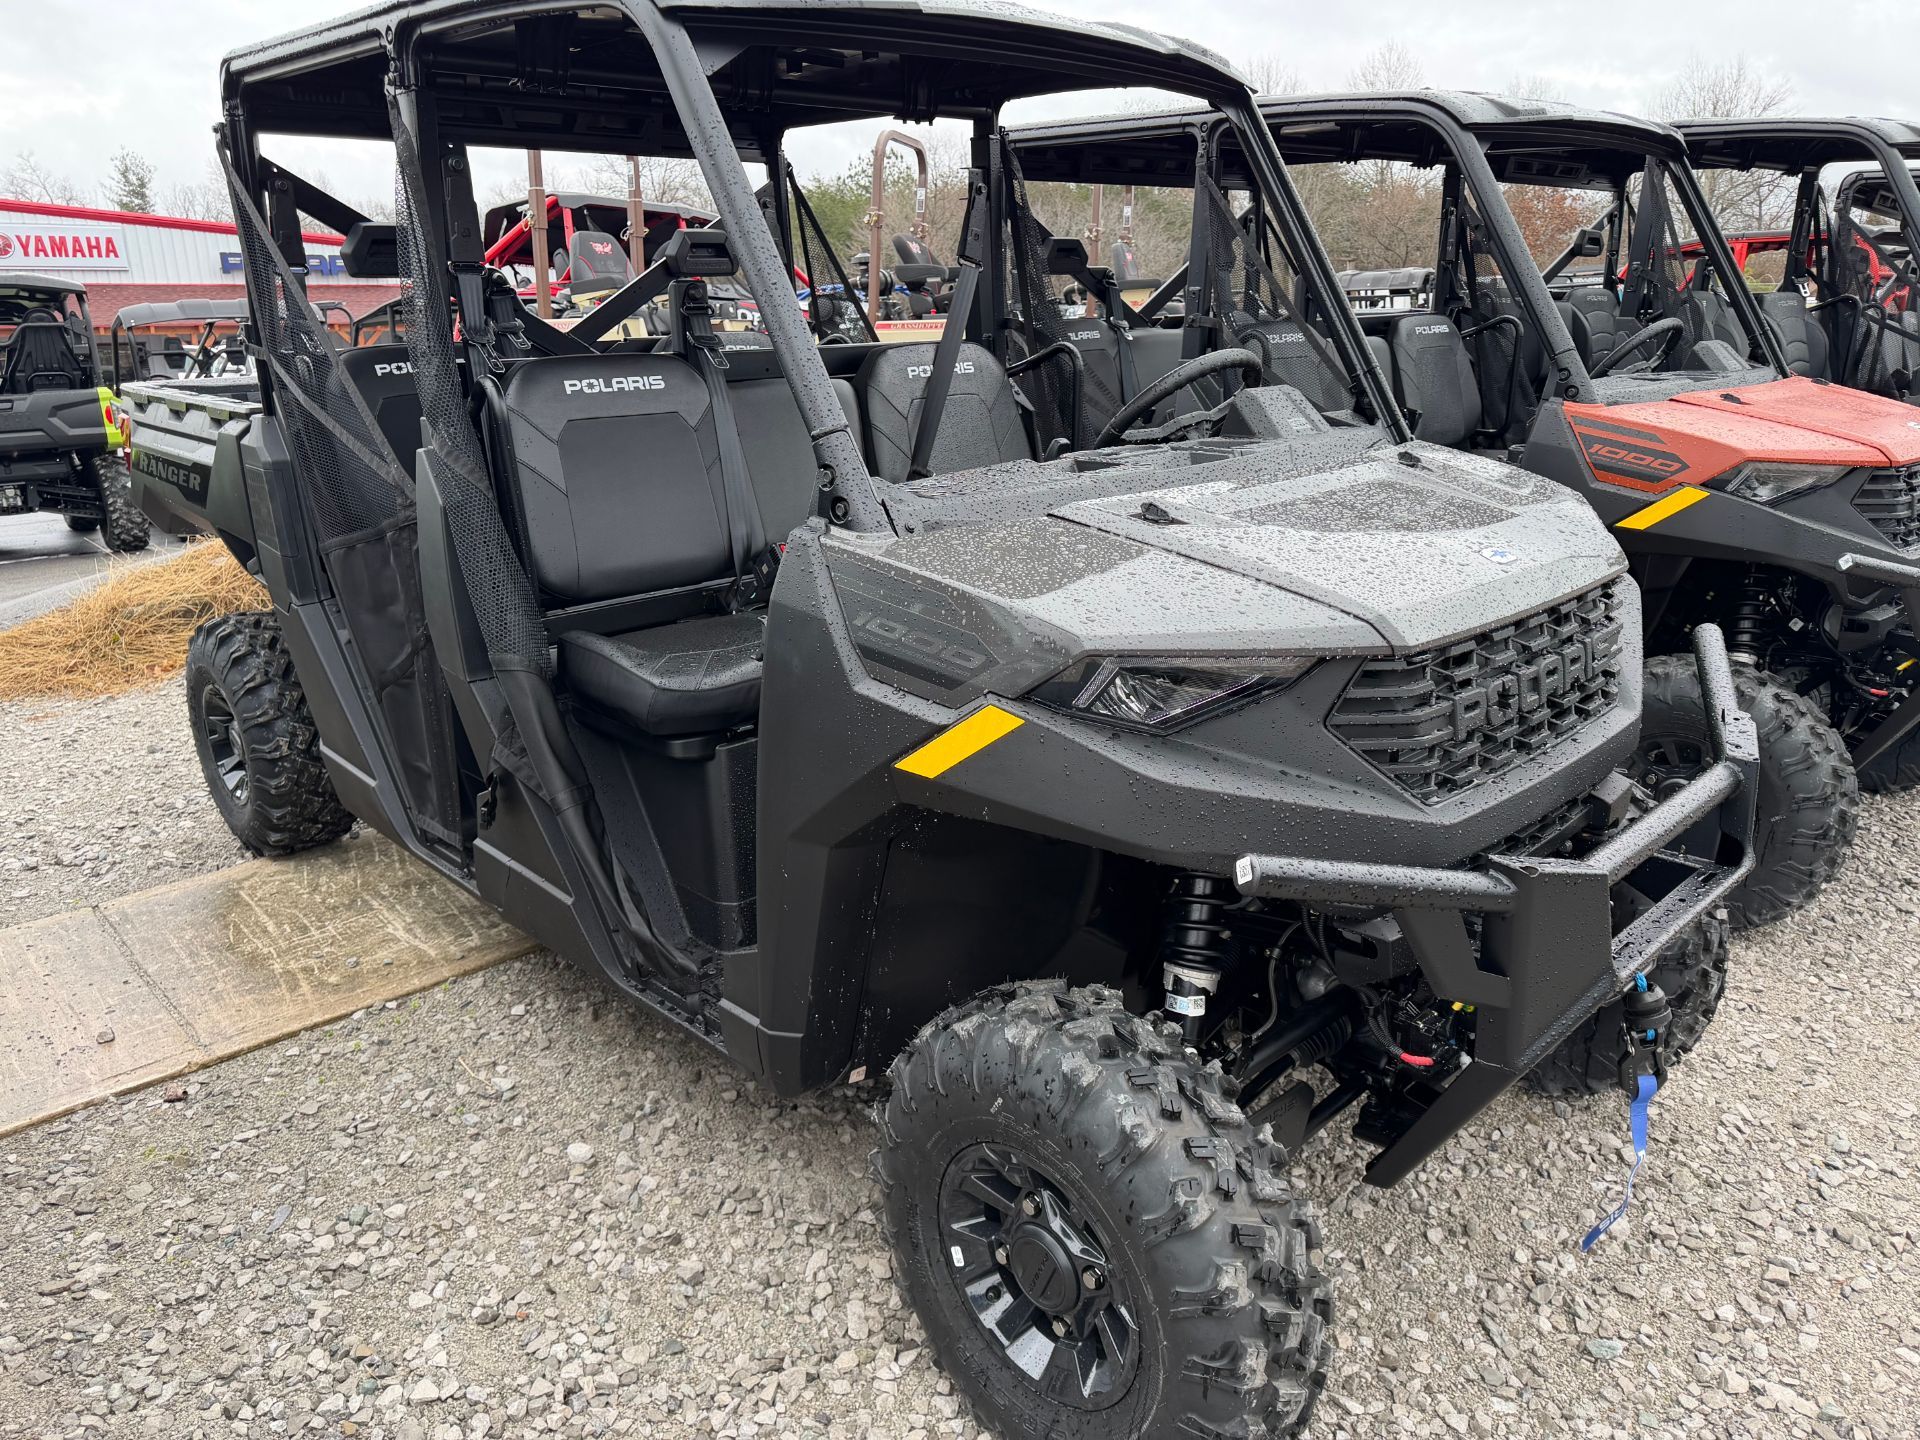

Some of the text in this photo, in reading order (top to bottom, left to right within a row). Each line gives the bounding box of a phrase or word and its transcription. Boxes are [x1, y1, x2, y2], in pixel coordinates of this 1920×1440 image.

[15, 234, 120, 258] YAMAHA
[890, 322, 946, 330] GRASSHOPPE
[1415, 324, 1450, 335] POLARIS
[563, 375, 666, 395] POLARIS
[1588, 443, 1682, 472] 1000
[139, 453, 201, 492] RANGER
[851, 610, 989, 669] 1000
